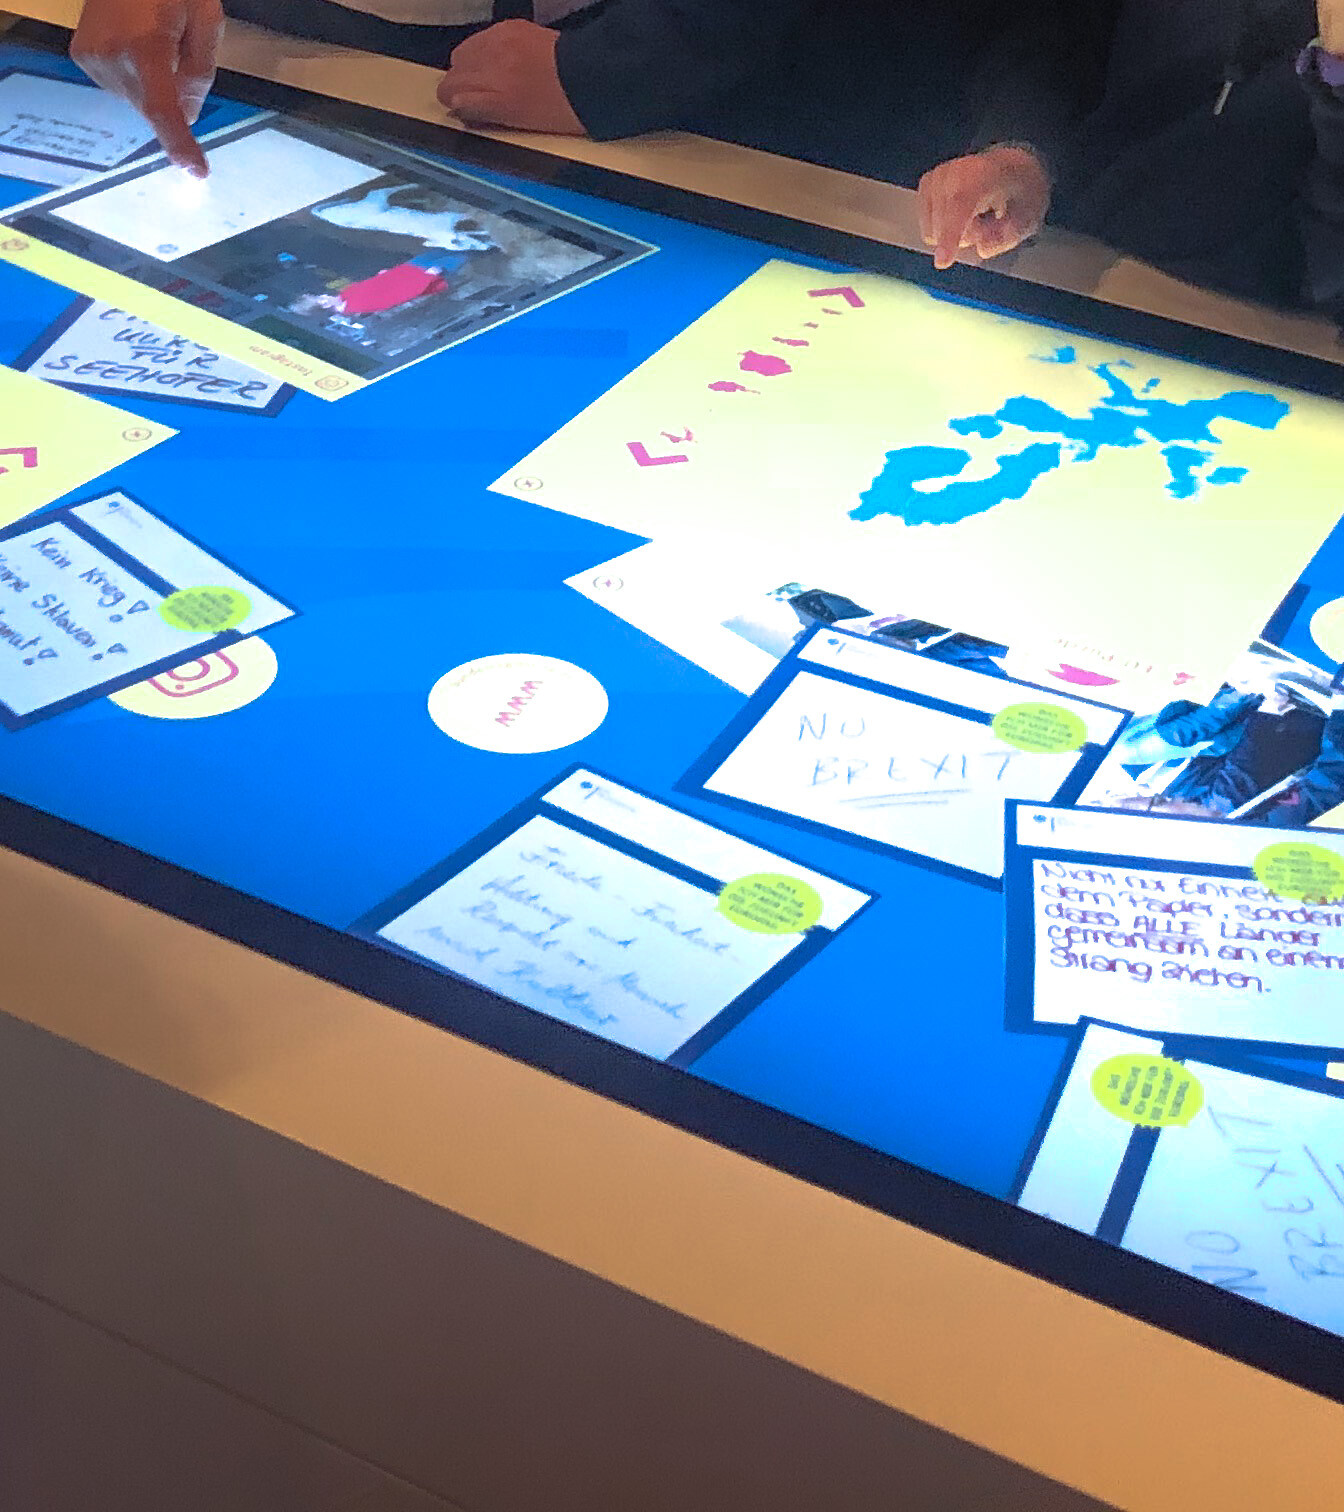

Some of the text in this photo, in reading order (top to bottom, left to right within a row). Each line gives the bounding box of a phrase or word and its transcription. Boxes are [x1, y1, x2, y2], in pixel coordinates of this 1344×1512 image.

[44, 355, 268, 401] SEEHOFER
[32, 537, 72, 570] Kein
[812, 754, 1016, 787] BREXIT
[1041, 882, 1115, 908] dem
[1134, 915, 1202, 938] ALLE
[1221, 919, 1321, 947] Länder
[1050, 946, 1153, 983] Strang
[1217, 945, 1259, 964] an
[1185, 1228, 1269, 1294] NO
